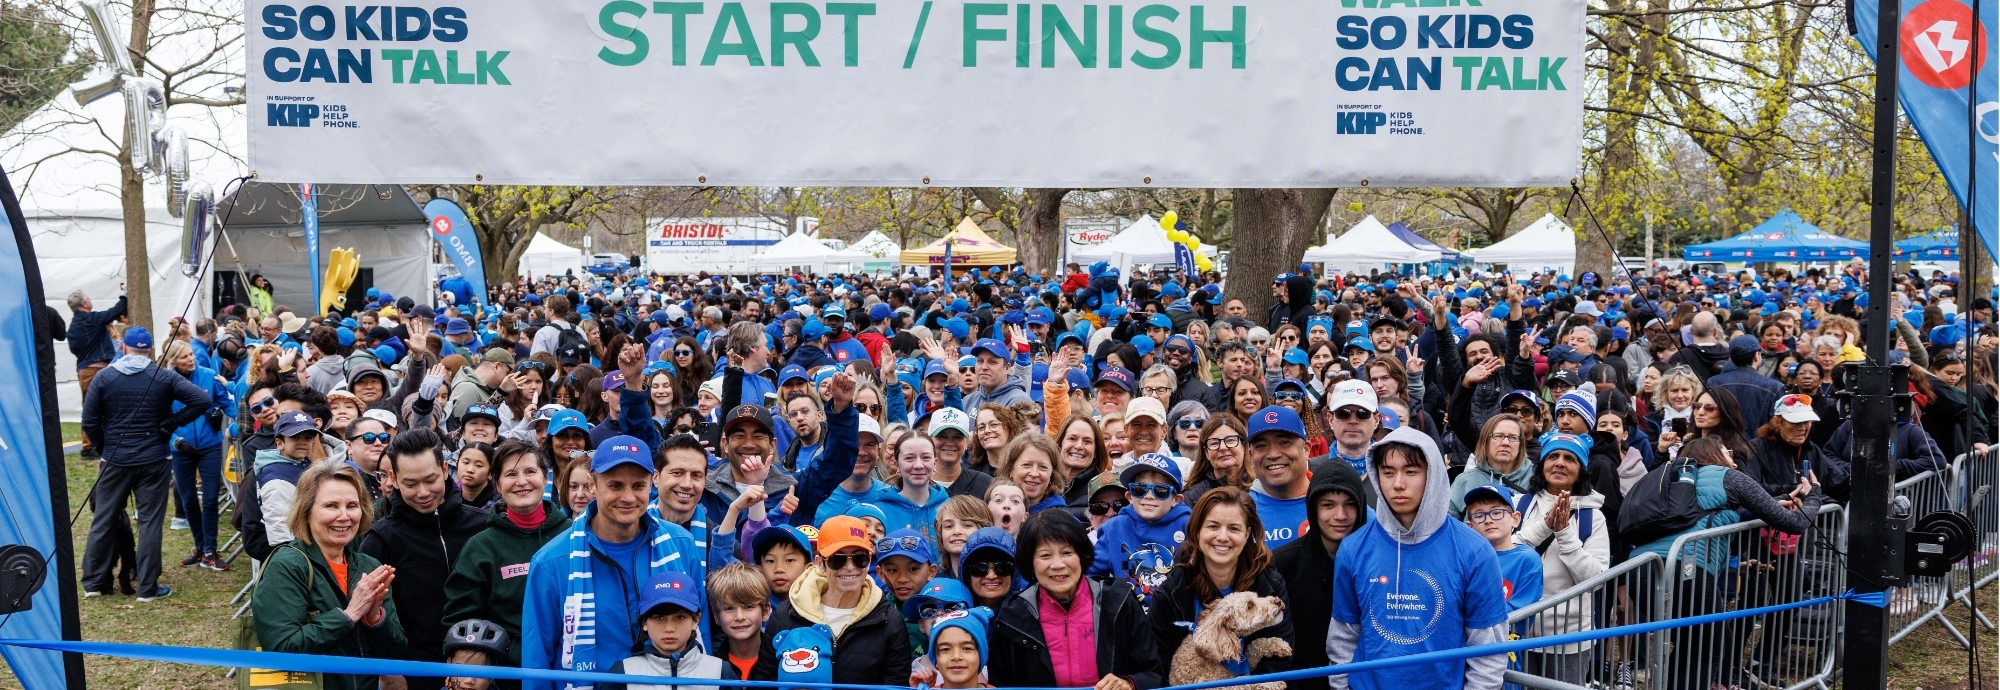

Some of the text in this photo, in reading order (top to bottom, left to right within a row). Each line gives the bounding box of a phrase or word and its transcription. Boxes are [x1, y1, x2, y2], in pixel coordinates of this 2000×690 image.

[262, 5, 468, 42] SO KIDS
[598, 0, 1246, 69] START / FINISH
[1336, 14, 1533, 50] SO KIDS
[263, 47, 510, 85] CAN TALK
[1335, 57, 1566, 91] CAN TALK
[266, 103, 320, 128] KHP
[1337, 112, 1386, 135] KHP
[662, 224, 723, 238] BRISTOL
[1079, 232, 1109, 242] Ryder
[1543, 266, 1564, 275] Bll
[1264, 411, 1278, 424] C
[1262, 528, 1292, 543] MO
[508, 567, 528, 575] FEEL
[654, 582, 671, 590] BMO
[1386, 592, 1420, 602] Everyone.
[1386, 602, 1428, 612] Everywhere.
